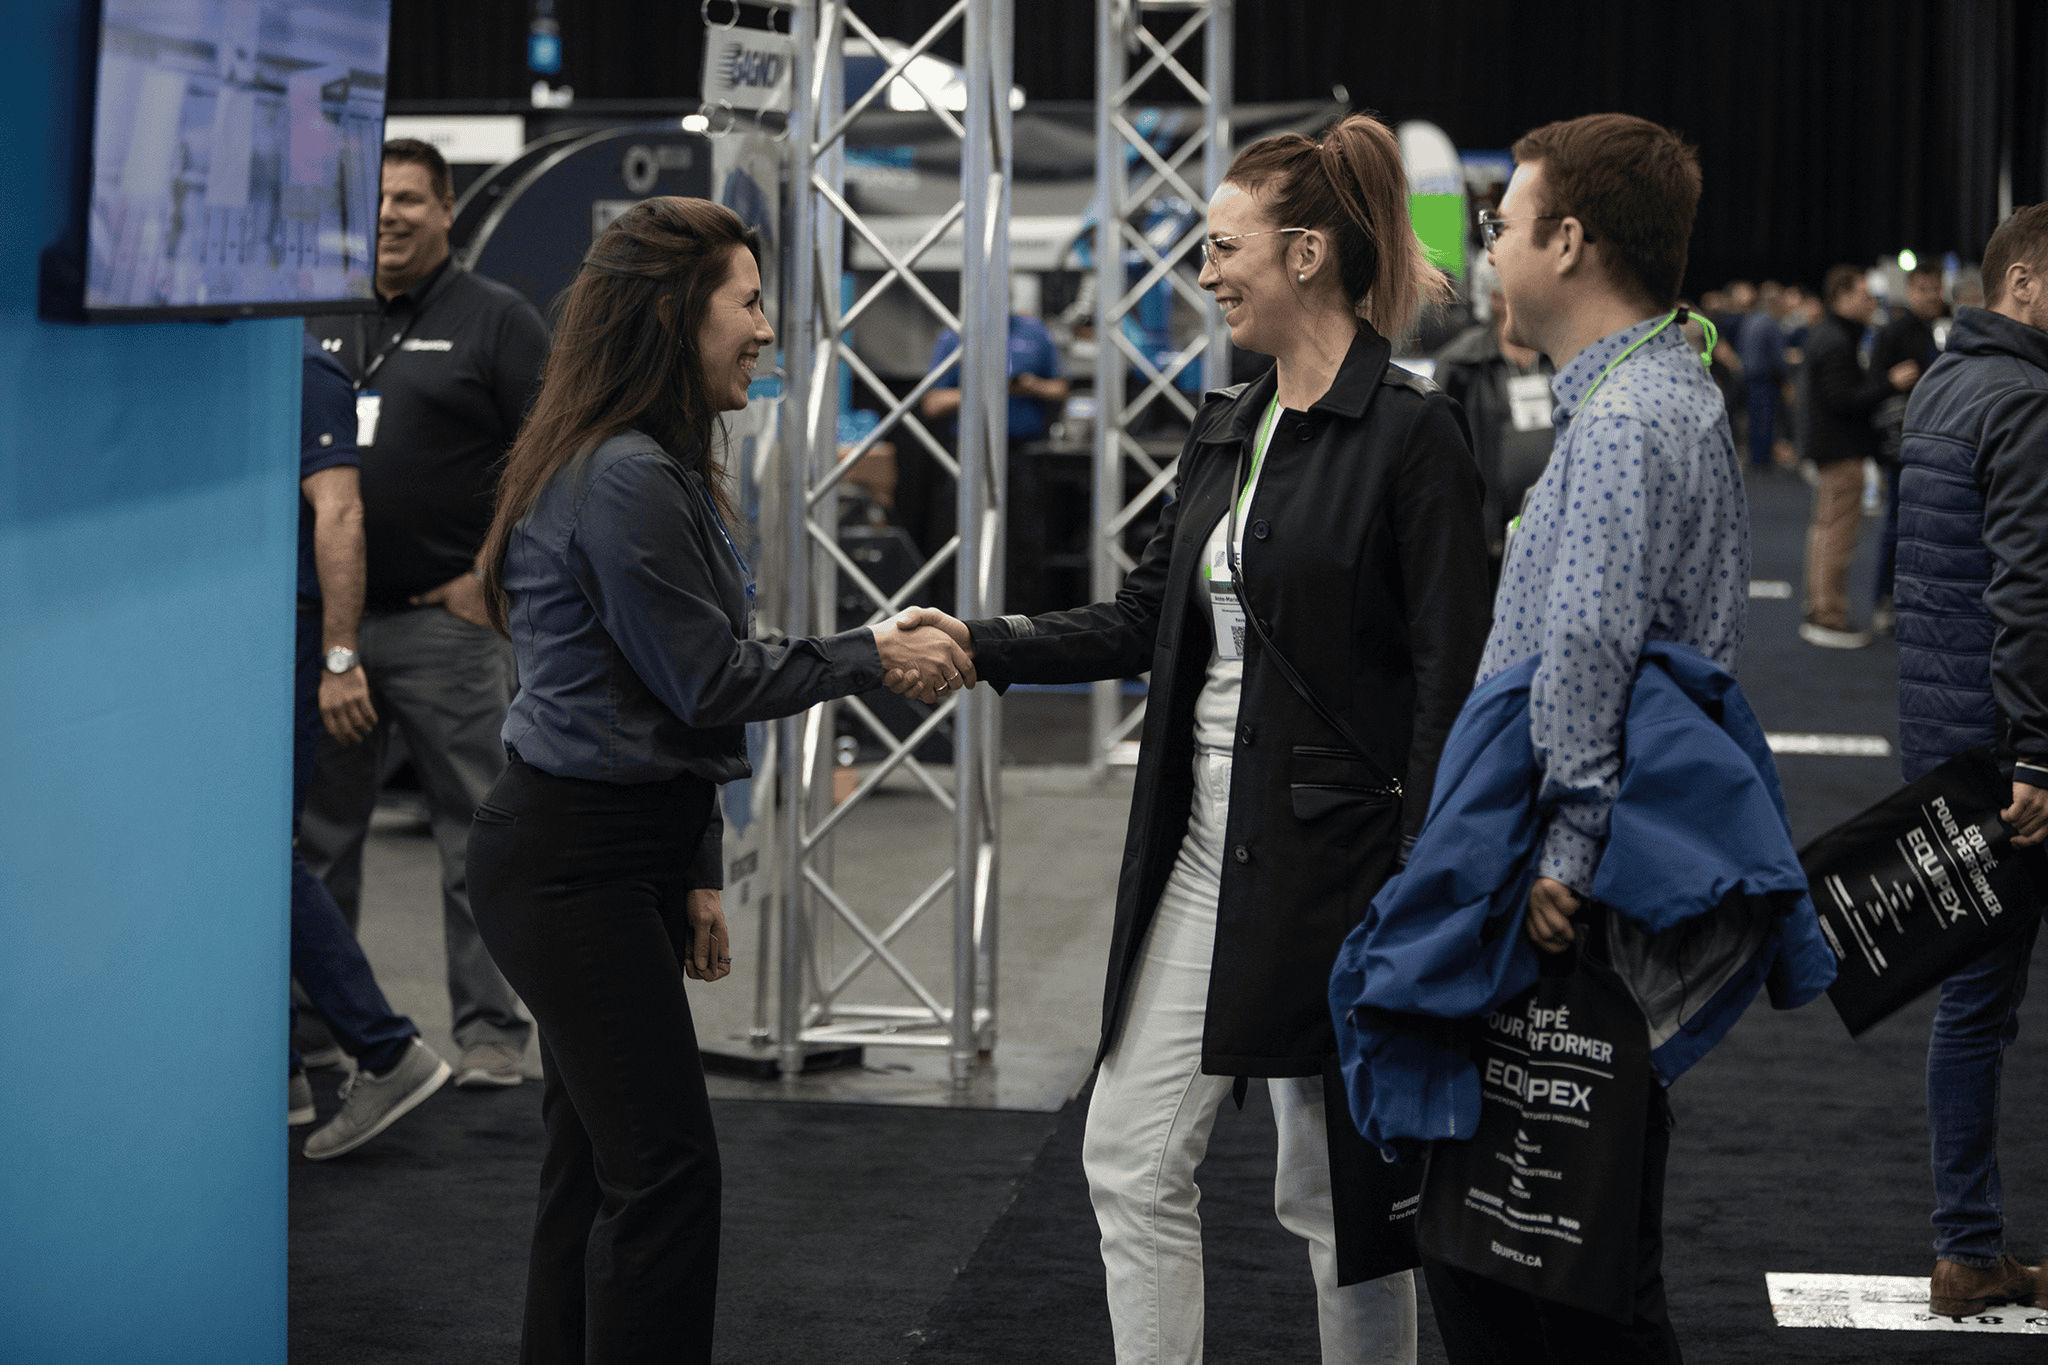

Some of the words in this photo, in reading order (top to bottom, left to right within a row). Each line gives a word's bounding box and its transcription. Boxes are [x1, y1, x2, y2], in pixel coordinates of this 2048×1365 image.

[1905, 826, 1968, 923] EQUIPEX
[1931, 795, 1960, 840] POUR
[1951, 835, 2003, 918] PERFORMER
[1488, 1009, 1526, 1040] OUR
[1491, 1240, 1543, 1268] EQUIPEX.CA
